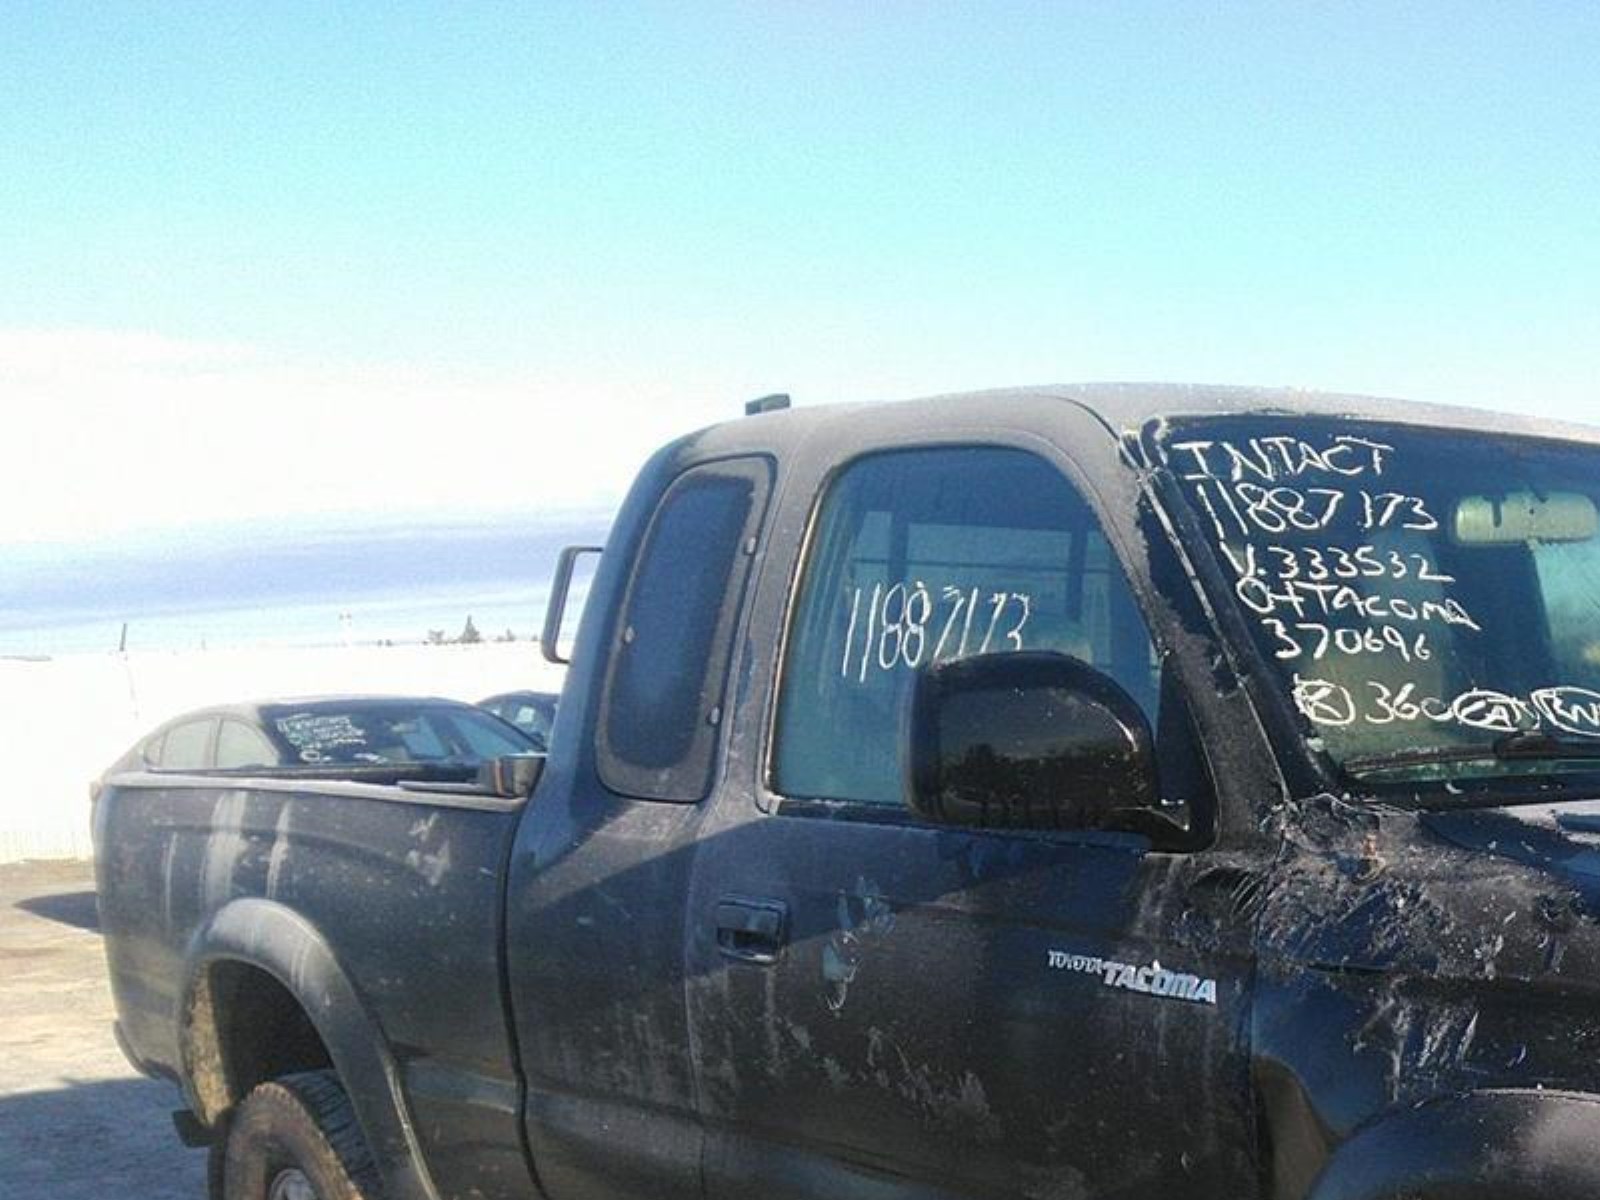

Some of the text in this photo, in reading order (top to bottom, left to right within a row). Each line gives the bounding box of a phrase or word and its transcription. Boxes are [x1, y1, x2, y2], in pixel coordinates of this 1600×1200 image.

[1171, 435, 1395, 482] INTACT
[1261, 618, 1432, 663] 370696
[1048, 949, 1217, 1004] TOYOTA TACOMA
